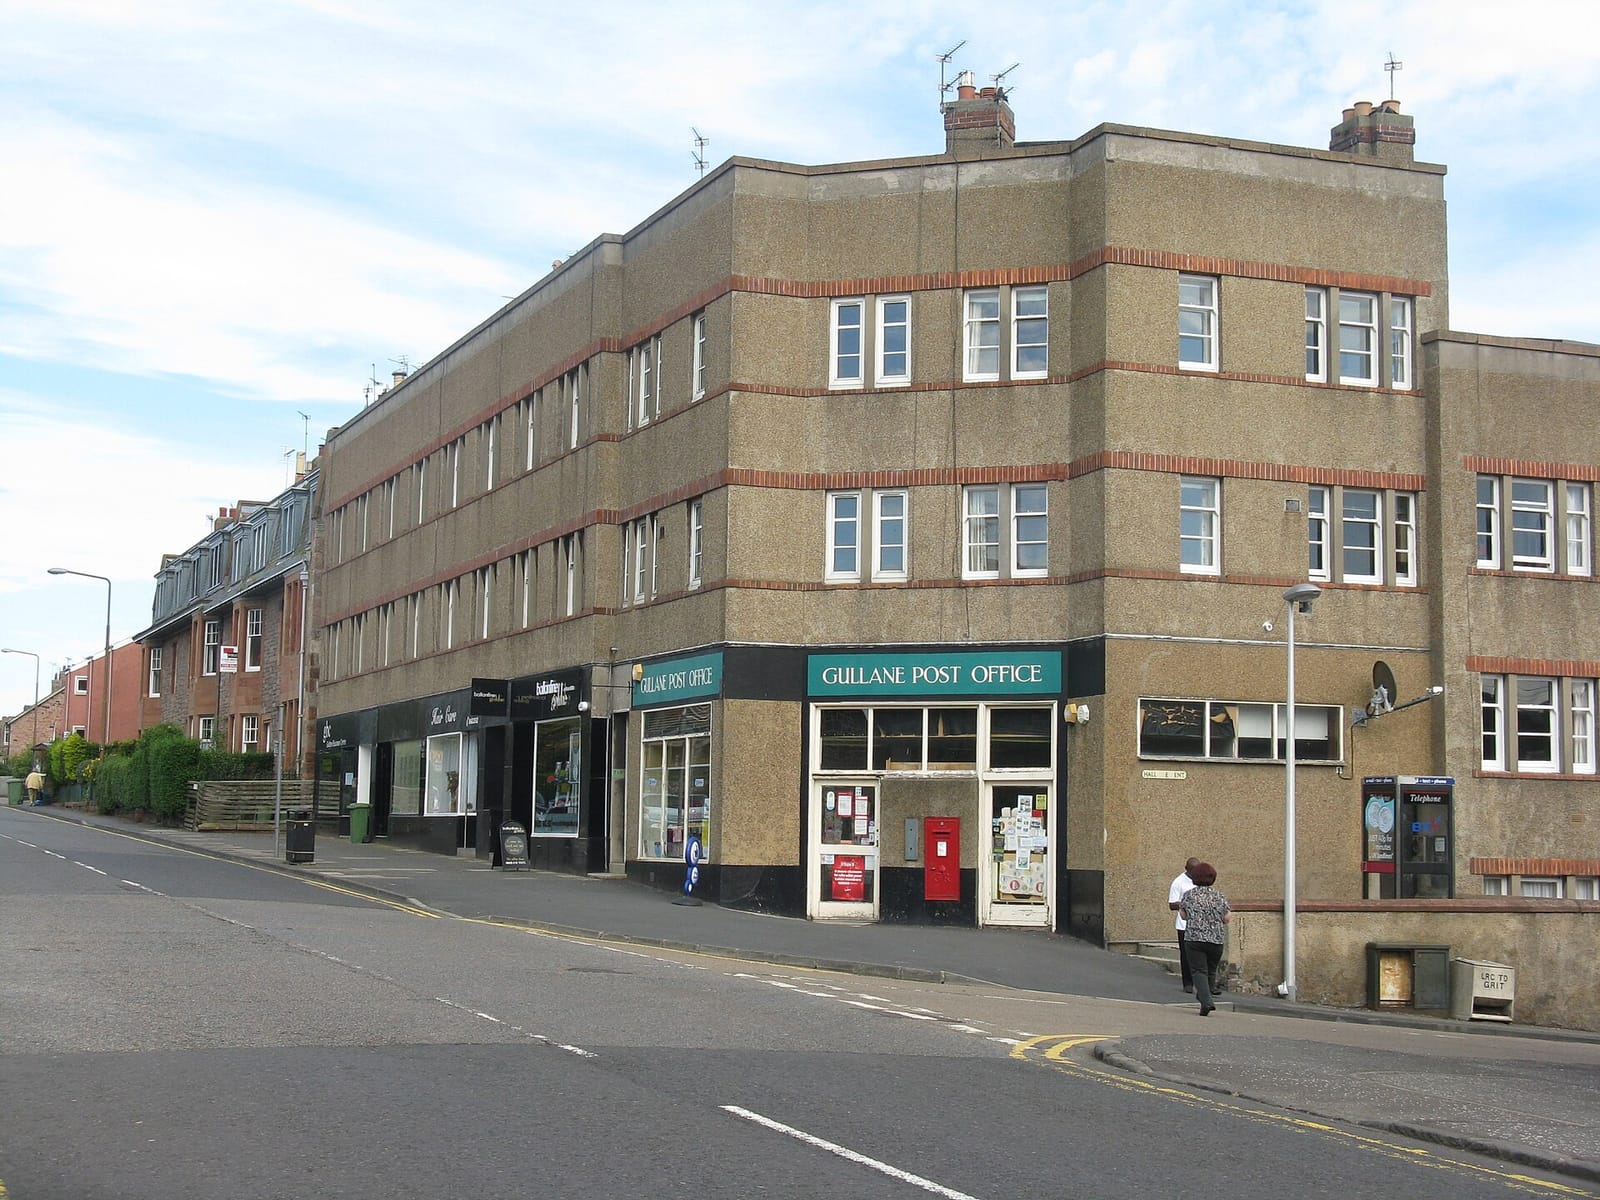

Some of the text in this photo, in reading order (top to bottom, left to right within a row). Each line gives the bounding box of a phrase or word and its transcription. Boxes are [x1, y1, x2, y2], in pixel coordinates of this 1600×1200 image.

[640, 667, 713, 694] GULLANE POST OFFICE
[822, 665, 1042, 685] GULLANE POST OFFICE
[1410, 794, 1441, 803] Telephone
[1483, 981, 1505, 991] GRIT
